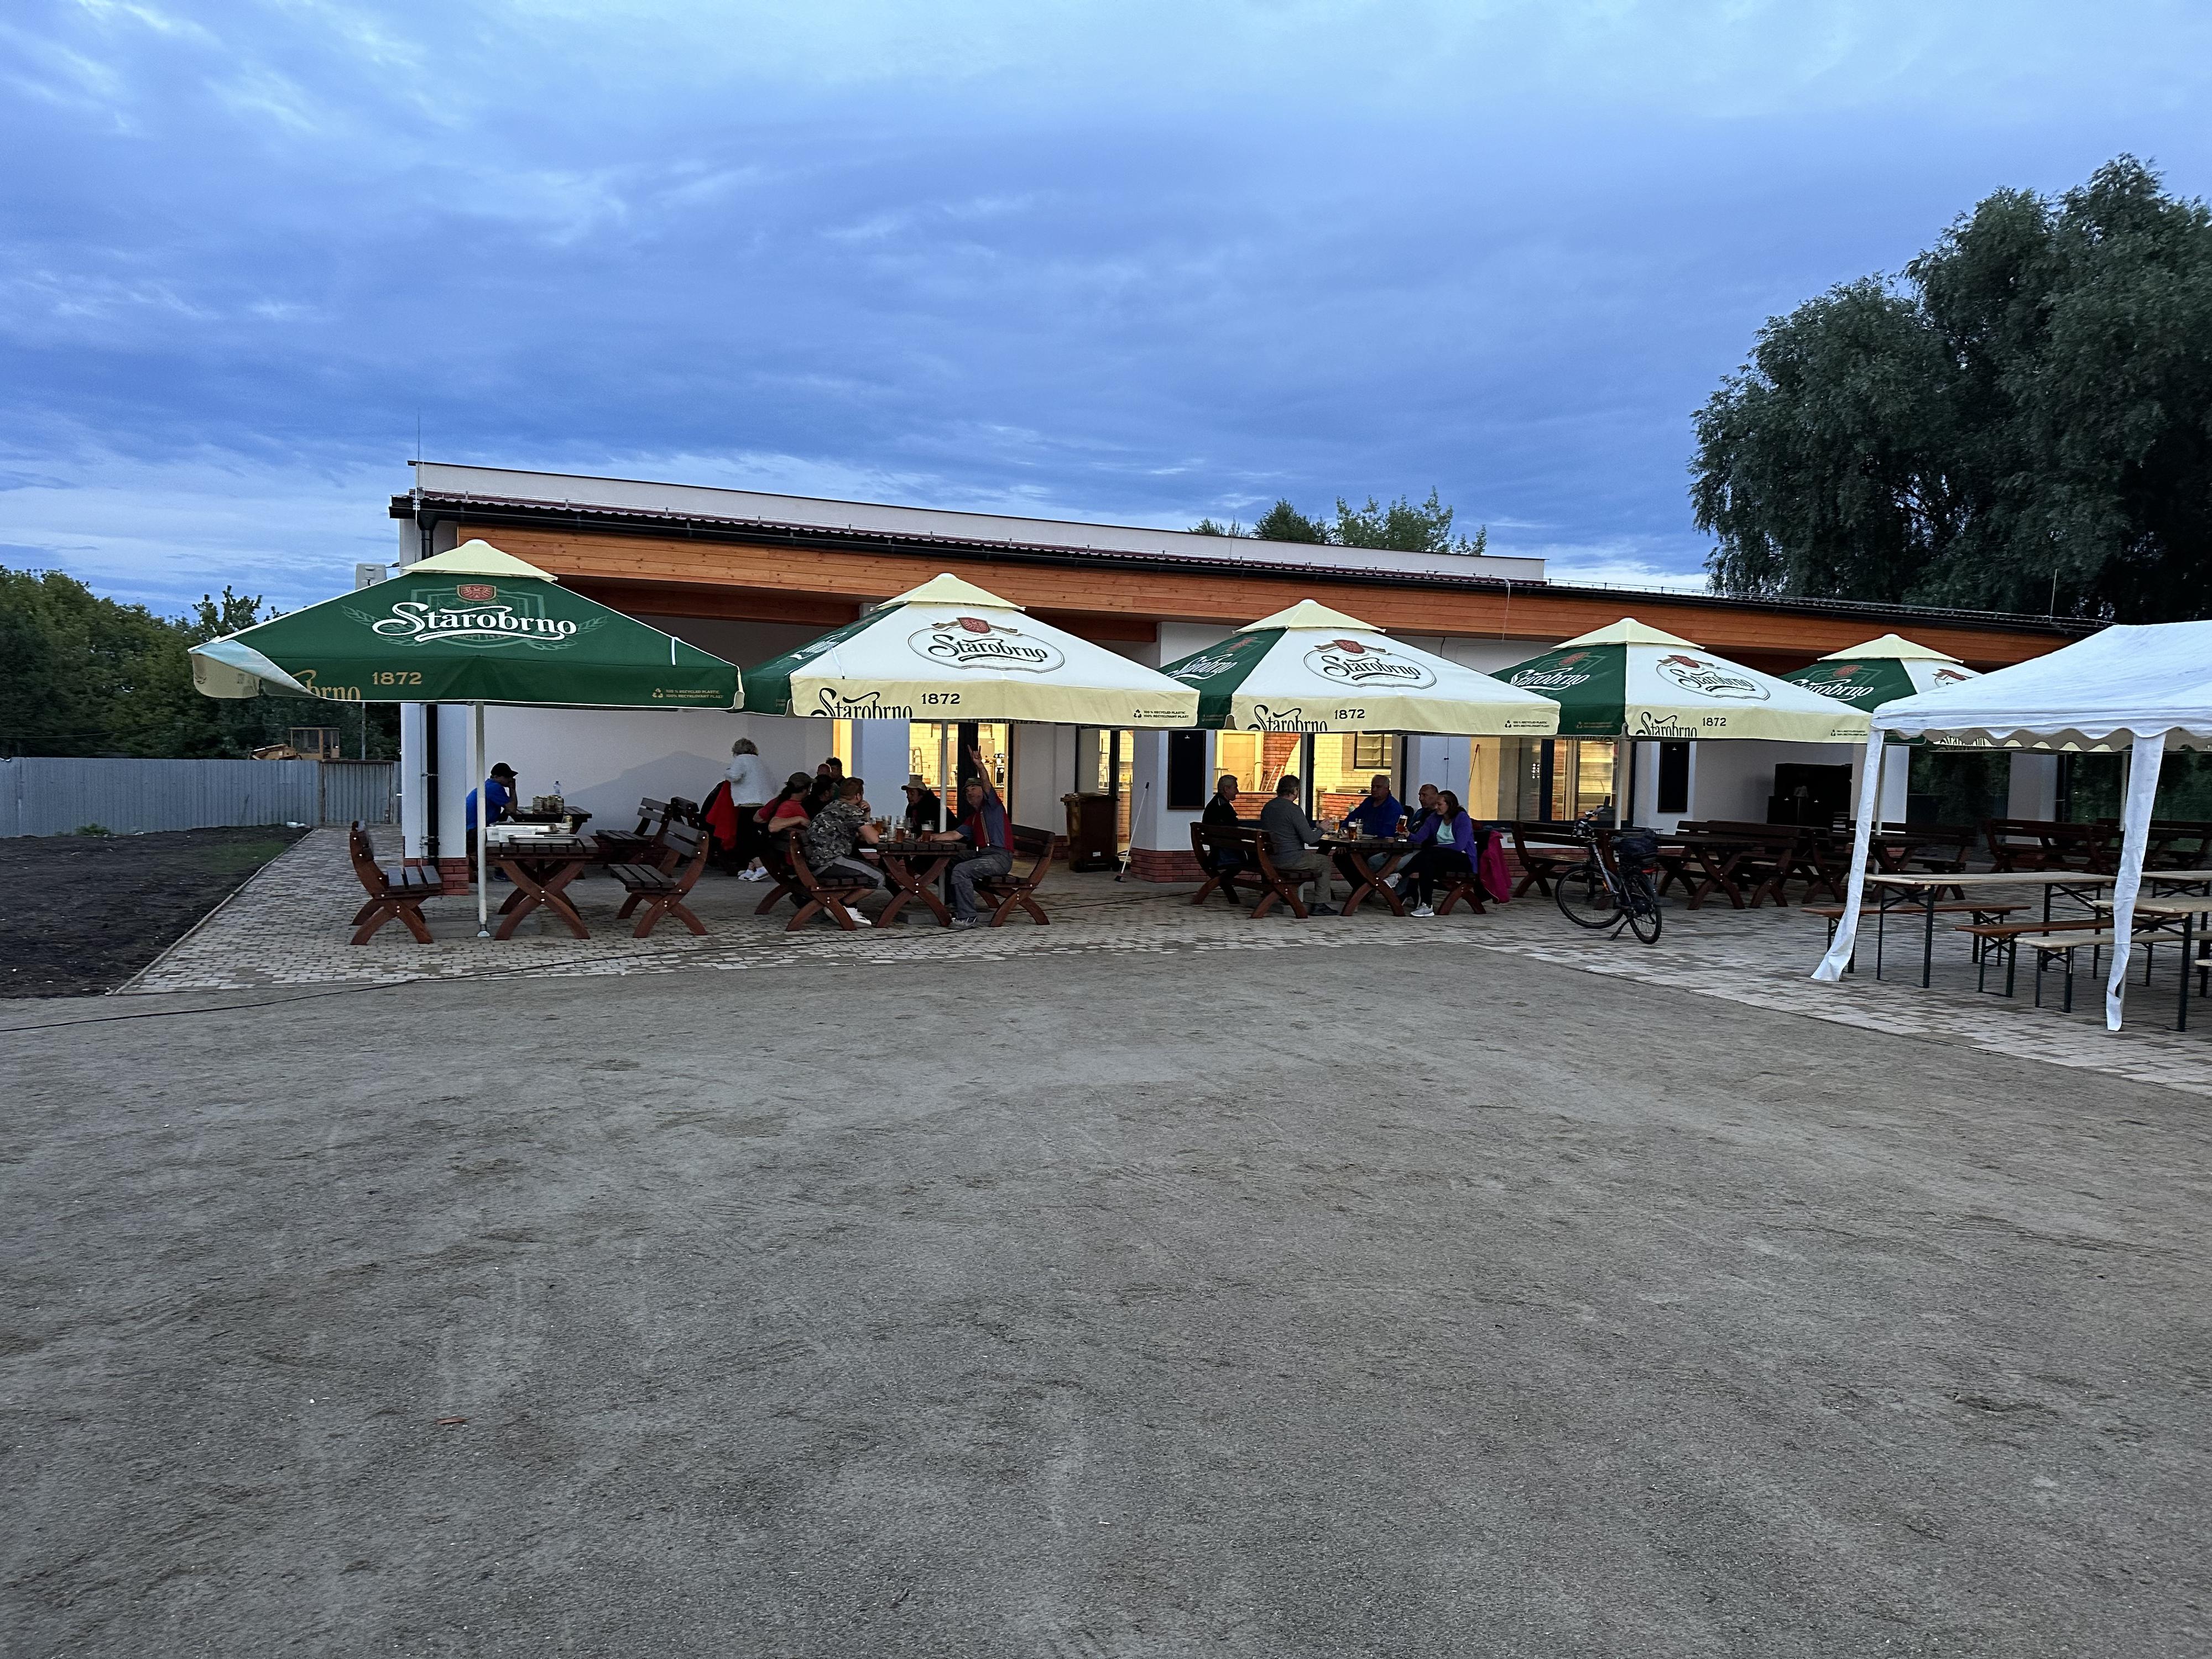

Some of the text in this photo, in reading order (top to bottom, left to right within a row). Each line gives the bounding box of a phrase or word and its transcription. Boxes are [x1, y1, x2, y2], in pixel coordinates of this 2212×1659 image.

[372, 602, 577, 642] Starobrno
[928, 634, 1047, 662] Starobrno
[1322, 655, 1422, 681] Starobrno
[372, 671, 422, 685] 1872
[921, 693, 961, 705] 1872
[1334, 709, 1365, 719] 1872
[1703, 717, 1726, 726] 1872
